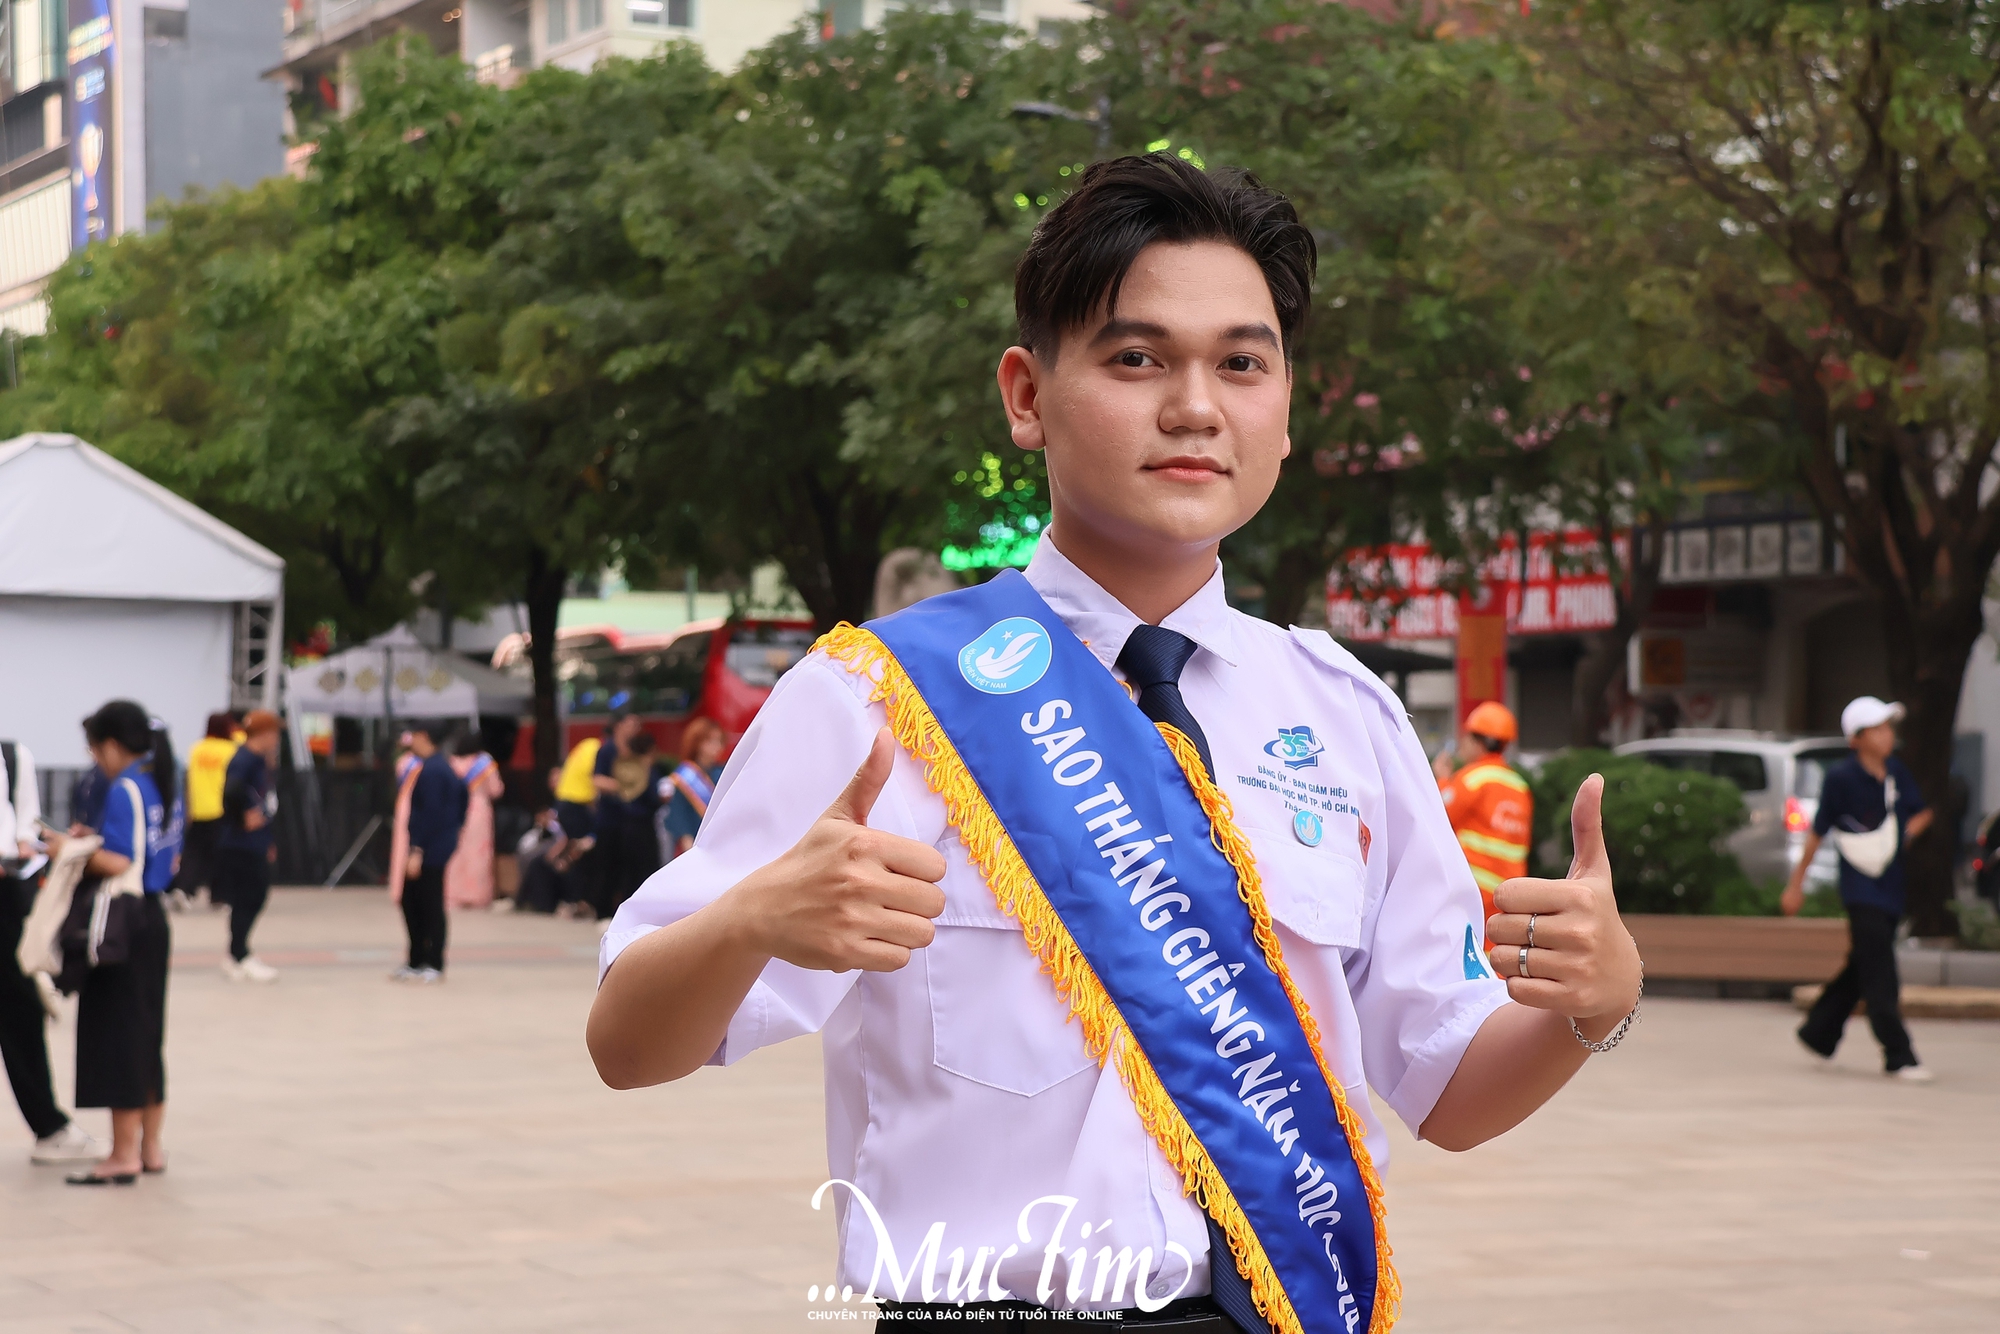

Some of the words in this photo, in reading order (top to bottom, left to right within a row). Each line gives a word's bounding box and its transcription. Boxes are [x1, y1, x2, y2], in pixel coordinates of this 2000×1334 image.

[975, 676, 990, 687] VIỆT
[1281, 734, 1310, 757] 35
[1236, 775, 1267, 789] TRƯỜNG
[1269, 781, 1281, 794] ĐẠI
[1281, 787, 1296, 799] HỌC
[1321, 799, 1332, 811] HỒ
[1334, 802, 1348, 814] CHÍ
[1292, 778, 1307, 790] BAN
[1308, 783, 1327, 796] GIÁM
[1330, 786, 1348, 799] HIỆU
[1020, 699, 1103, 787] SAO
[1073, 781, 1191, 932] THÁNG
[1161, 927, 1266, 1059] GIÊNG
[1231, 1051, 1301, 1157] NĂM
[1294, 1151, 1342, 1229] HỌC
